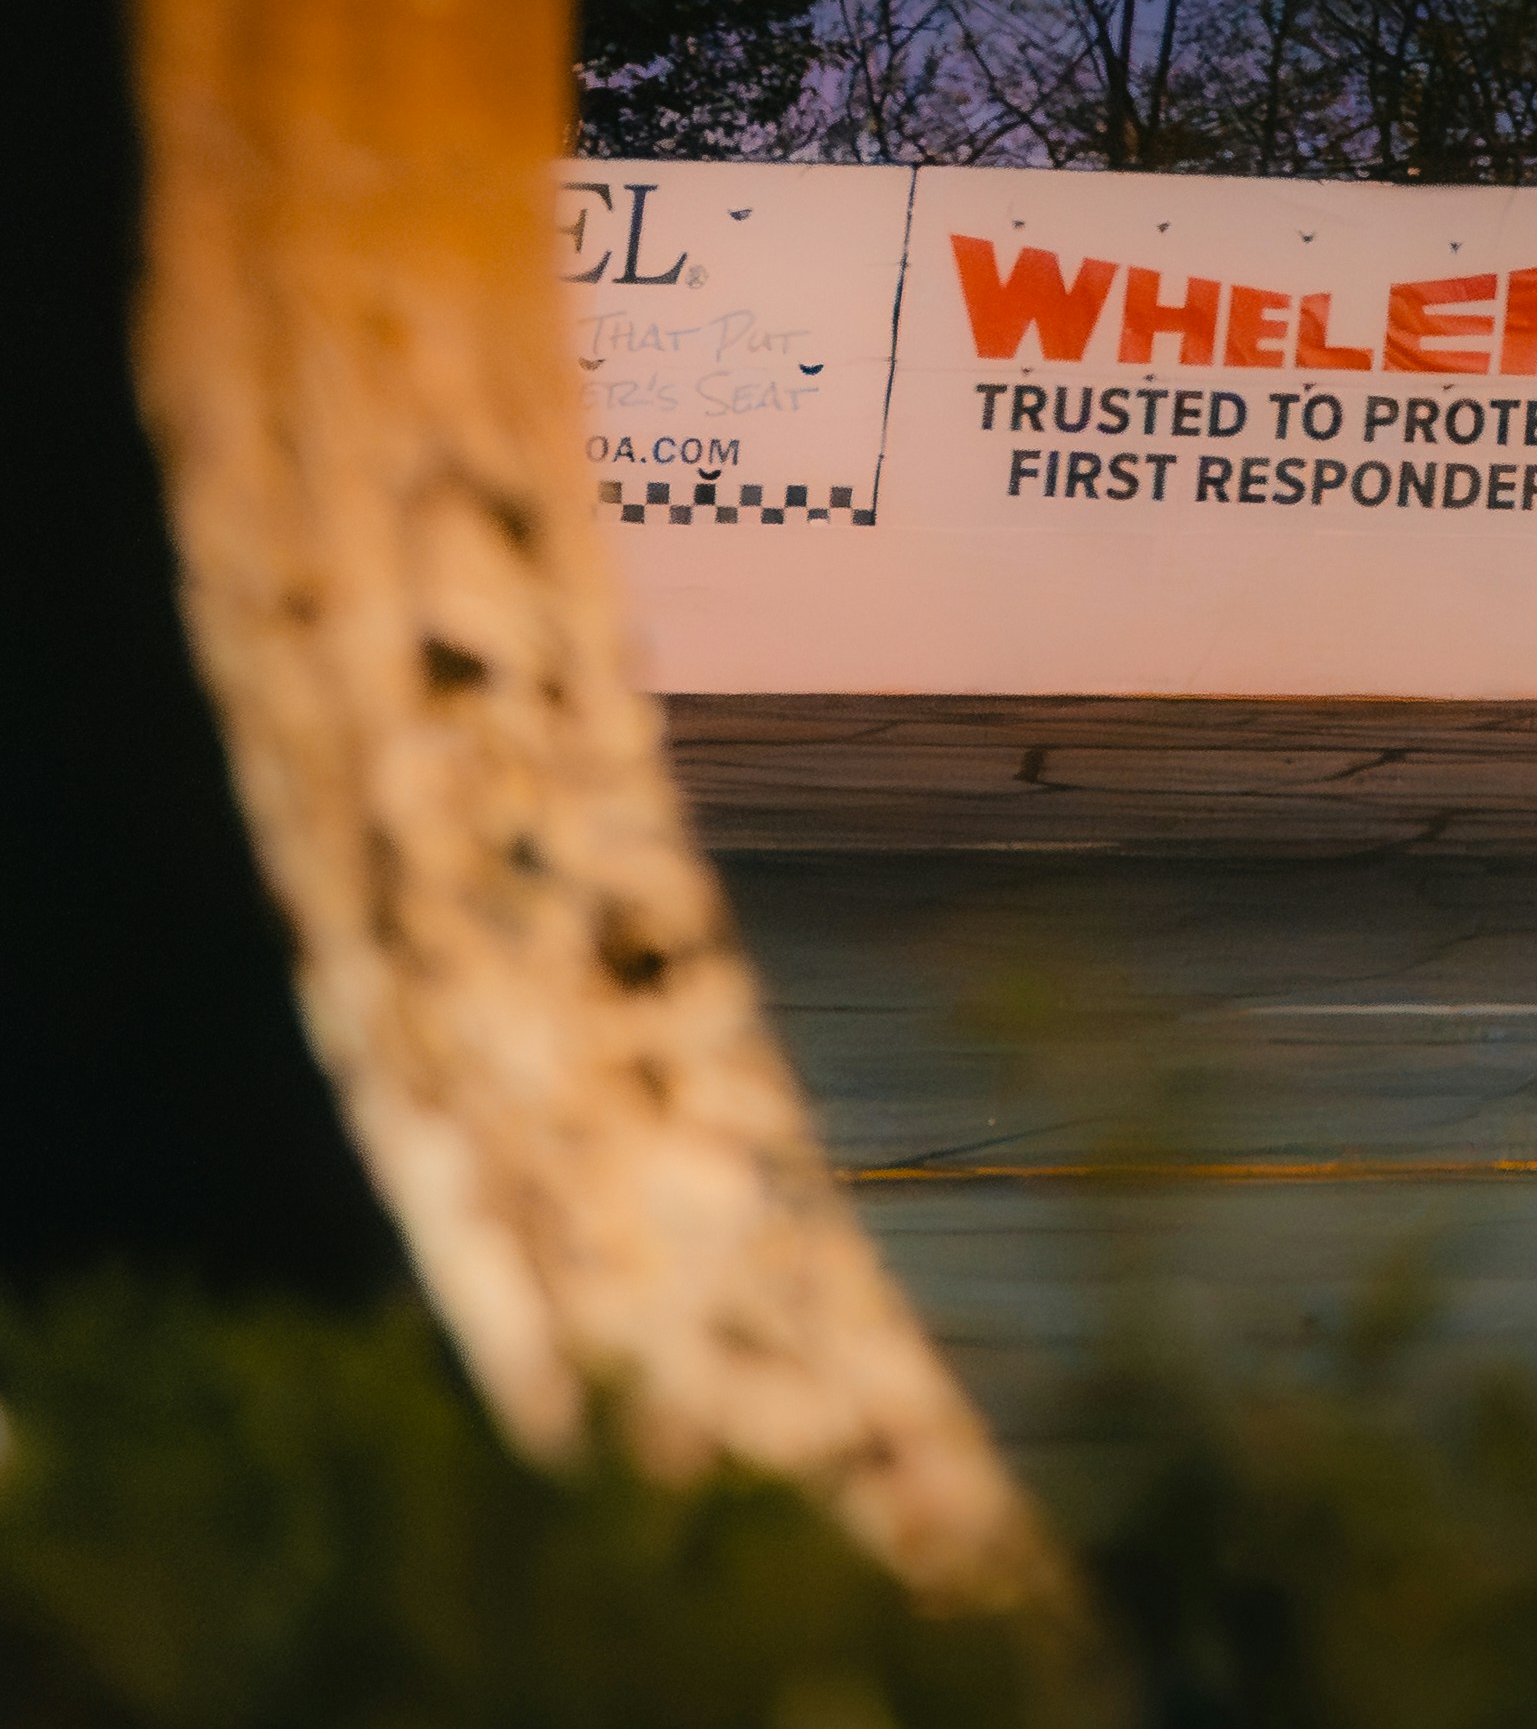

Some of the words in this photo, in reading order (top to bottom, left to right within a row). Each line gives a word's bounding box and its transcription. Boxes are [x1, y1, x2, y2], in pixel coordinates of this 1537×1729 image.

[694, 370, 821, 417] SEAT
[976, 383, 1246, 438] TRUSTED
[1270, 392, 1344, 442] TO
[1007, 449, 1177, 503] FIRST
